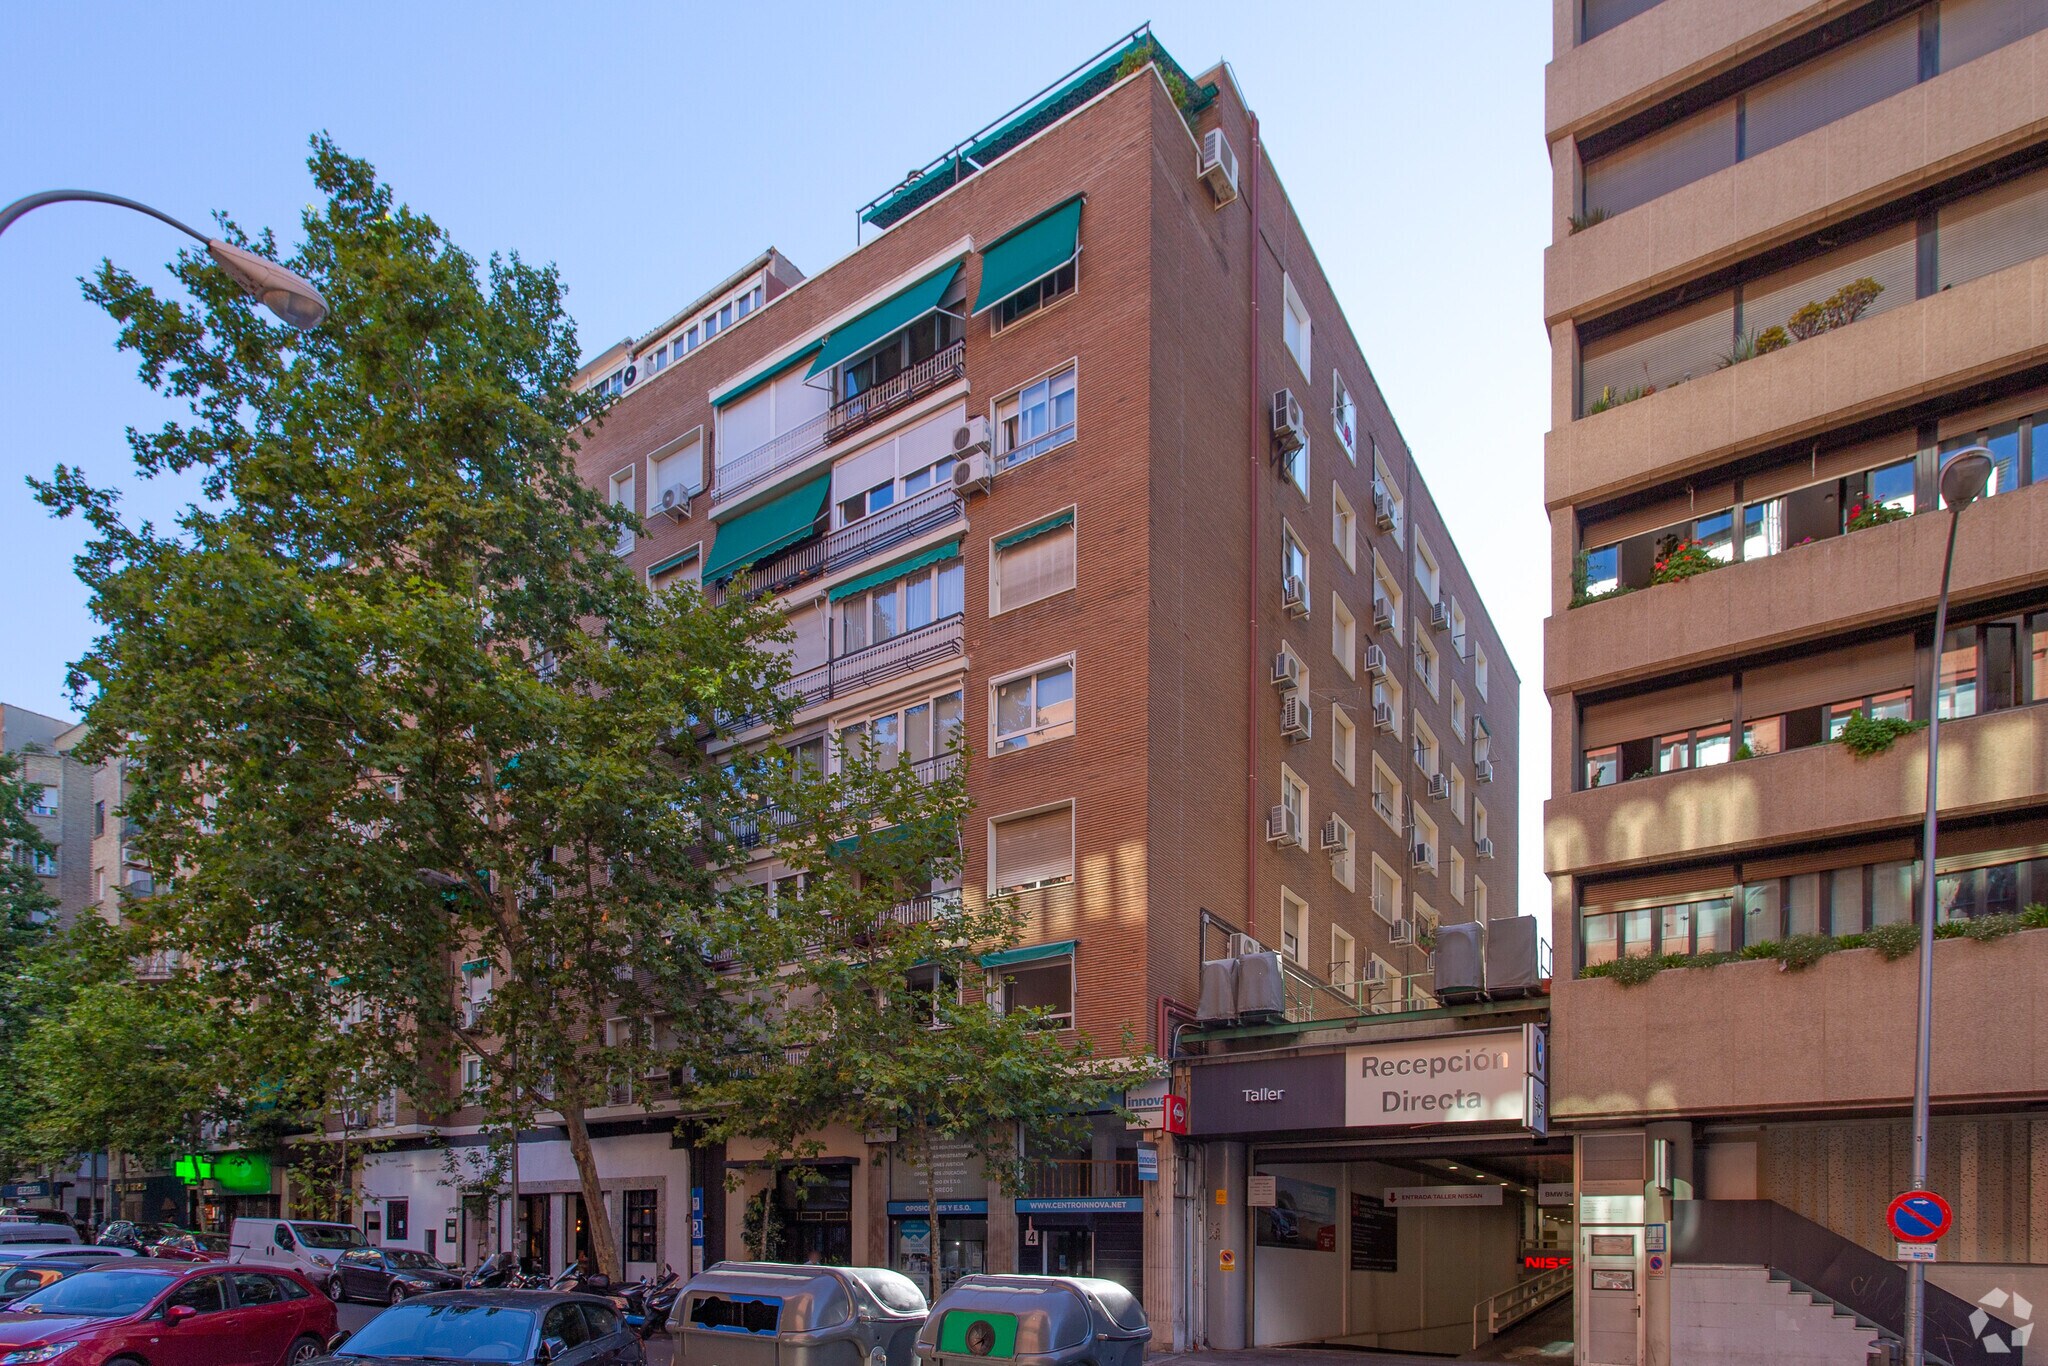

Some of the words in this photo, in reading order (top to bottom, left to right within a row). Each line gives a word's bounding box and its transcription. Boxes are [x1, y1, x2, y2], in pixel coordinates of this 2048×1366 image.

[1362, 1048, 1509, 1079] Recepción
[1242, 1087, 1285, 1102] Taller
[1382, 1088, 1482, 1112] Directa
[1030, 1201, 1127, 1209] WWW.CENTROINNOVA.NET
[1028, 1231, 1036, 1244] 4
